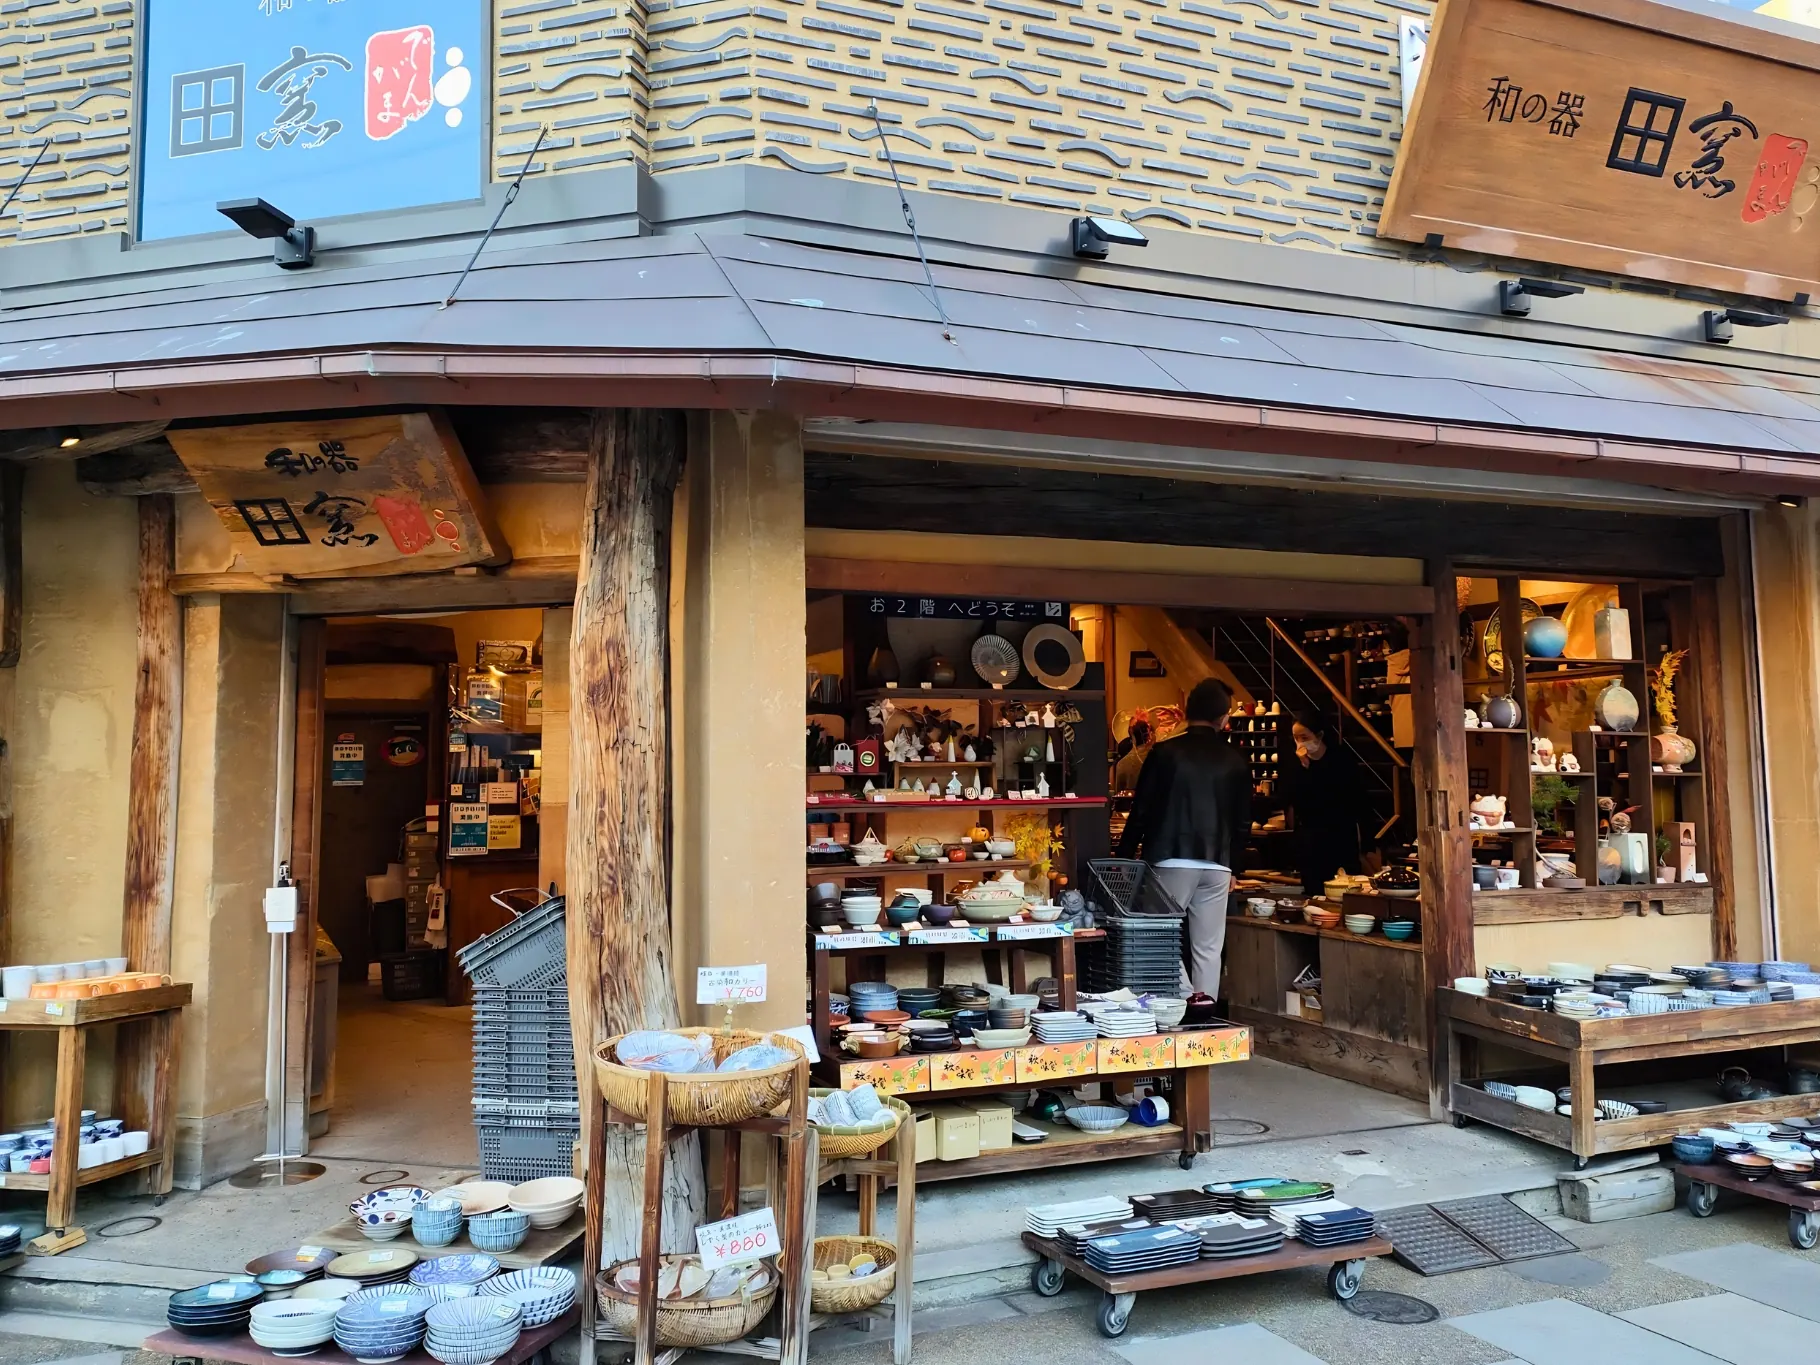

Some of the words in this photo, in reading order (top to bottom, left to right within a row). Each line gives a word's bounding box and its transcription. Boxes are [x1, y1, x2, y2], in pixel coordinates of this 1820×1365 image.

[1481, 75, 1586, 138] 和の器
[264, 440, 360, 478] 和の器
[943, 1060, 975, 1081] 秋の味覚
